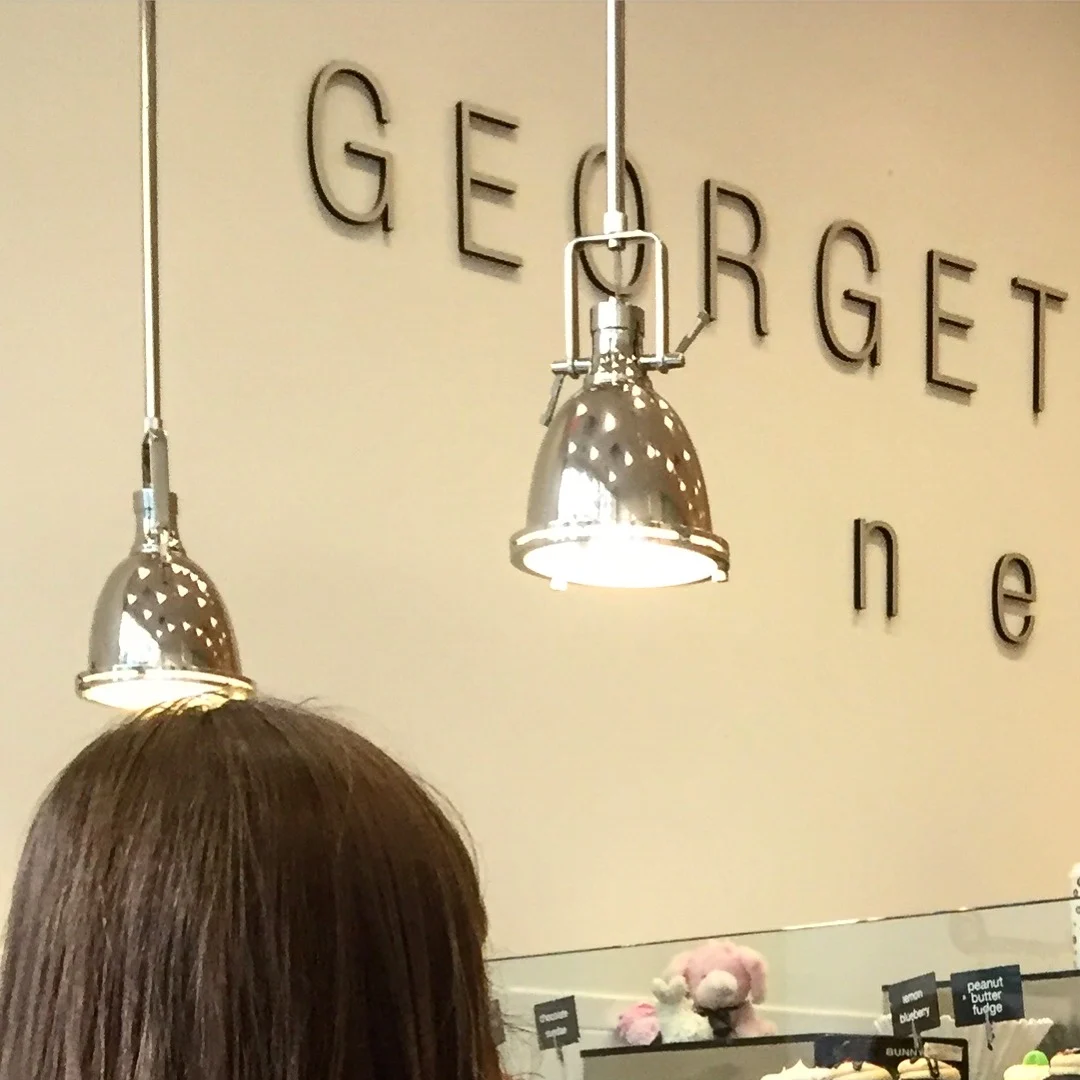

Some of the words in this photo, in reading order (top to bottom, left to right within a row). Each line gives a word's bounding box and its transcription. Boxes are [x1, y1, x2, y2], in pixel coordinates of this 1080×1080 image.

[967, 976, 1004, 993] peanut
[970, 990, 1003, 1004] butter
[972, 1002, 1003, 1017] fudge
